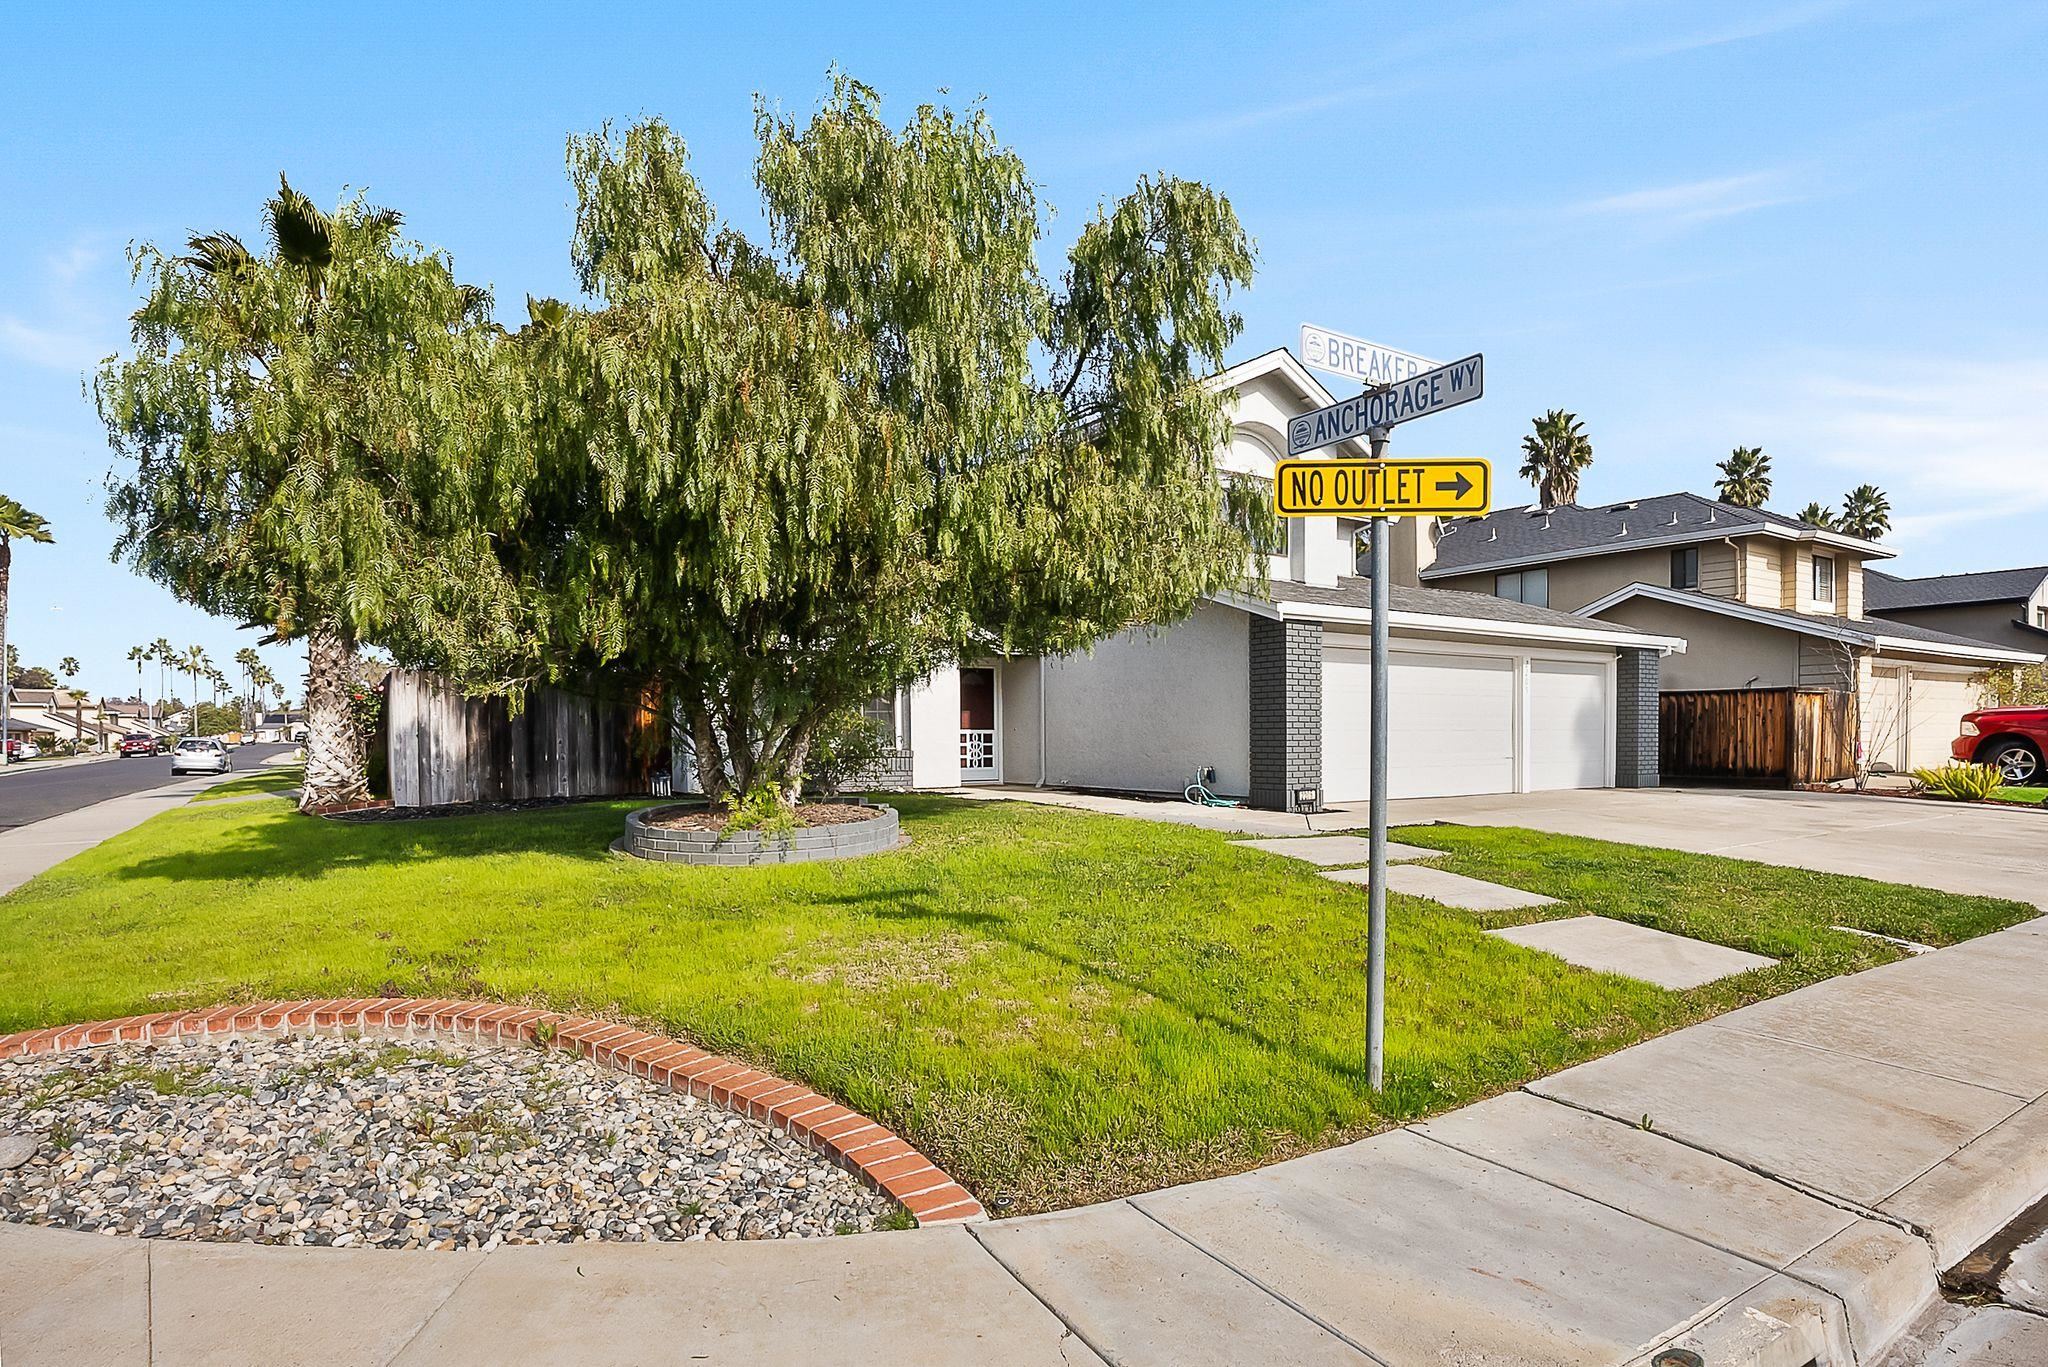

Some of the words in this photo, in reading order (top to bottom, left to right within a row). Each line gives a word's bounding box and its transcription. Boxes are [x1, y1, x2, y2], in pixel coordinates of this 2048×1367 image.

[1314, 373, 1444, 444] ANCHORAGE
[1449, 361, 1478, 393] WY
[1291, 470, 1324, 506] NO
[1334, 468, 1425, 506] OUTLET
